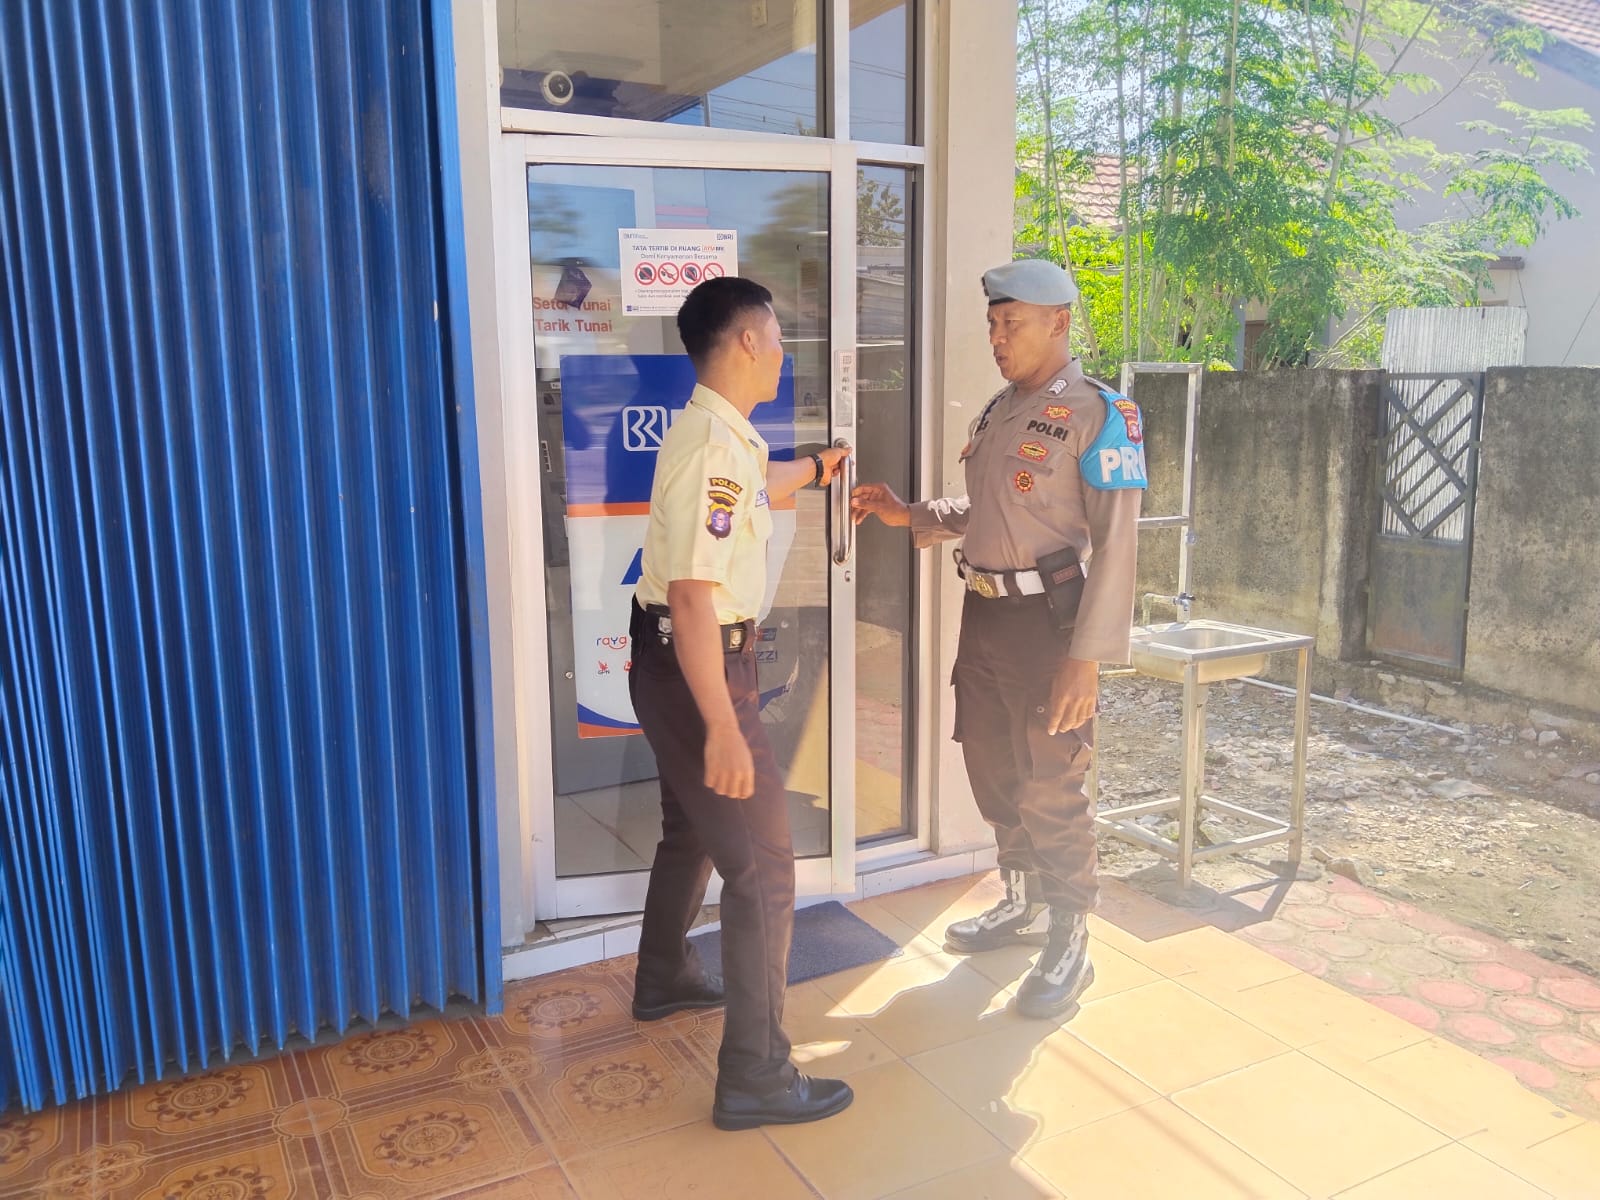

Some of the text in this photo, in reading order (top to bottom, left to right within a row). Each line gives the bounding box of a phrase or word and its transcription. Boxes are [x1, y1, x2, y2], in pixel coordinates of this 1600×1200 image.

[576, 298, 612, 312] unai
[534, 318, 613, 332] Tarik Tunai
[1027, 420, 1068, 441] POLRI
[710, 478, 741, 494] POLDA
[596, 636, 627, 646] raya
